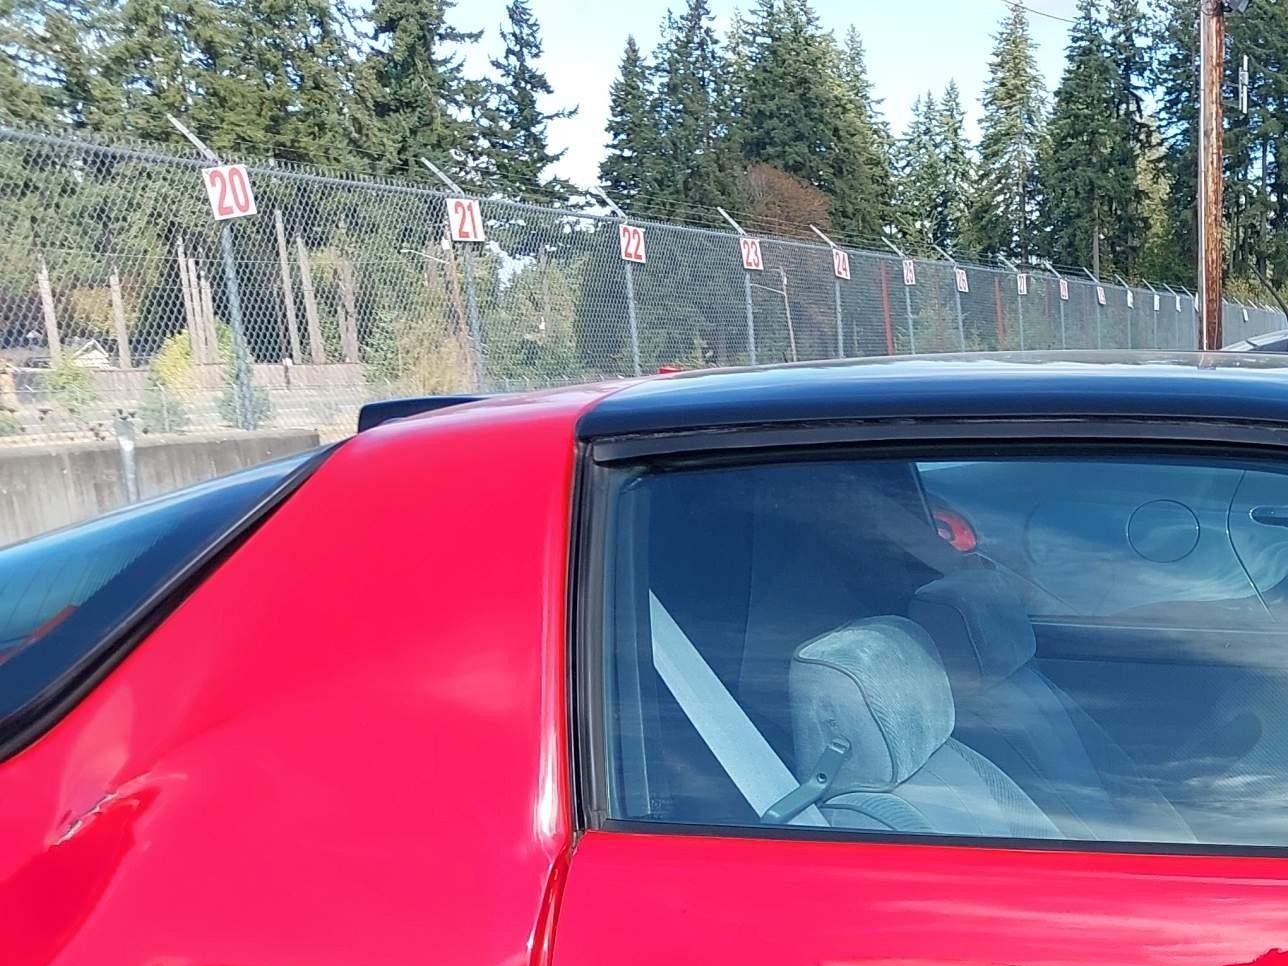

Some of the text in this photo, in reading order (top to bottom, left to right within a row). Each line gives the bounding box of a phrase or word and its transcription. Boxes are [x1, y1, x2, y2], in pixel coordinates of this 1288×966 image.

[209, 167, 250, 216] 20
[454, 200, 478, 239] 21
[622, 226, 643, 260] 22
[743, 240, 760, 268] 23
[834, 251, 849, 277] 24
